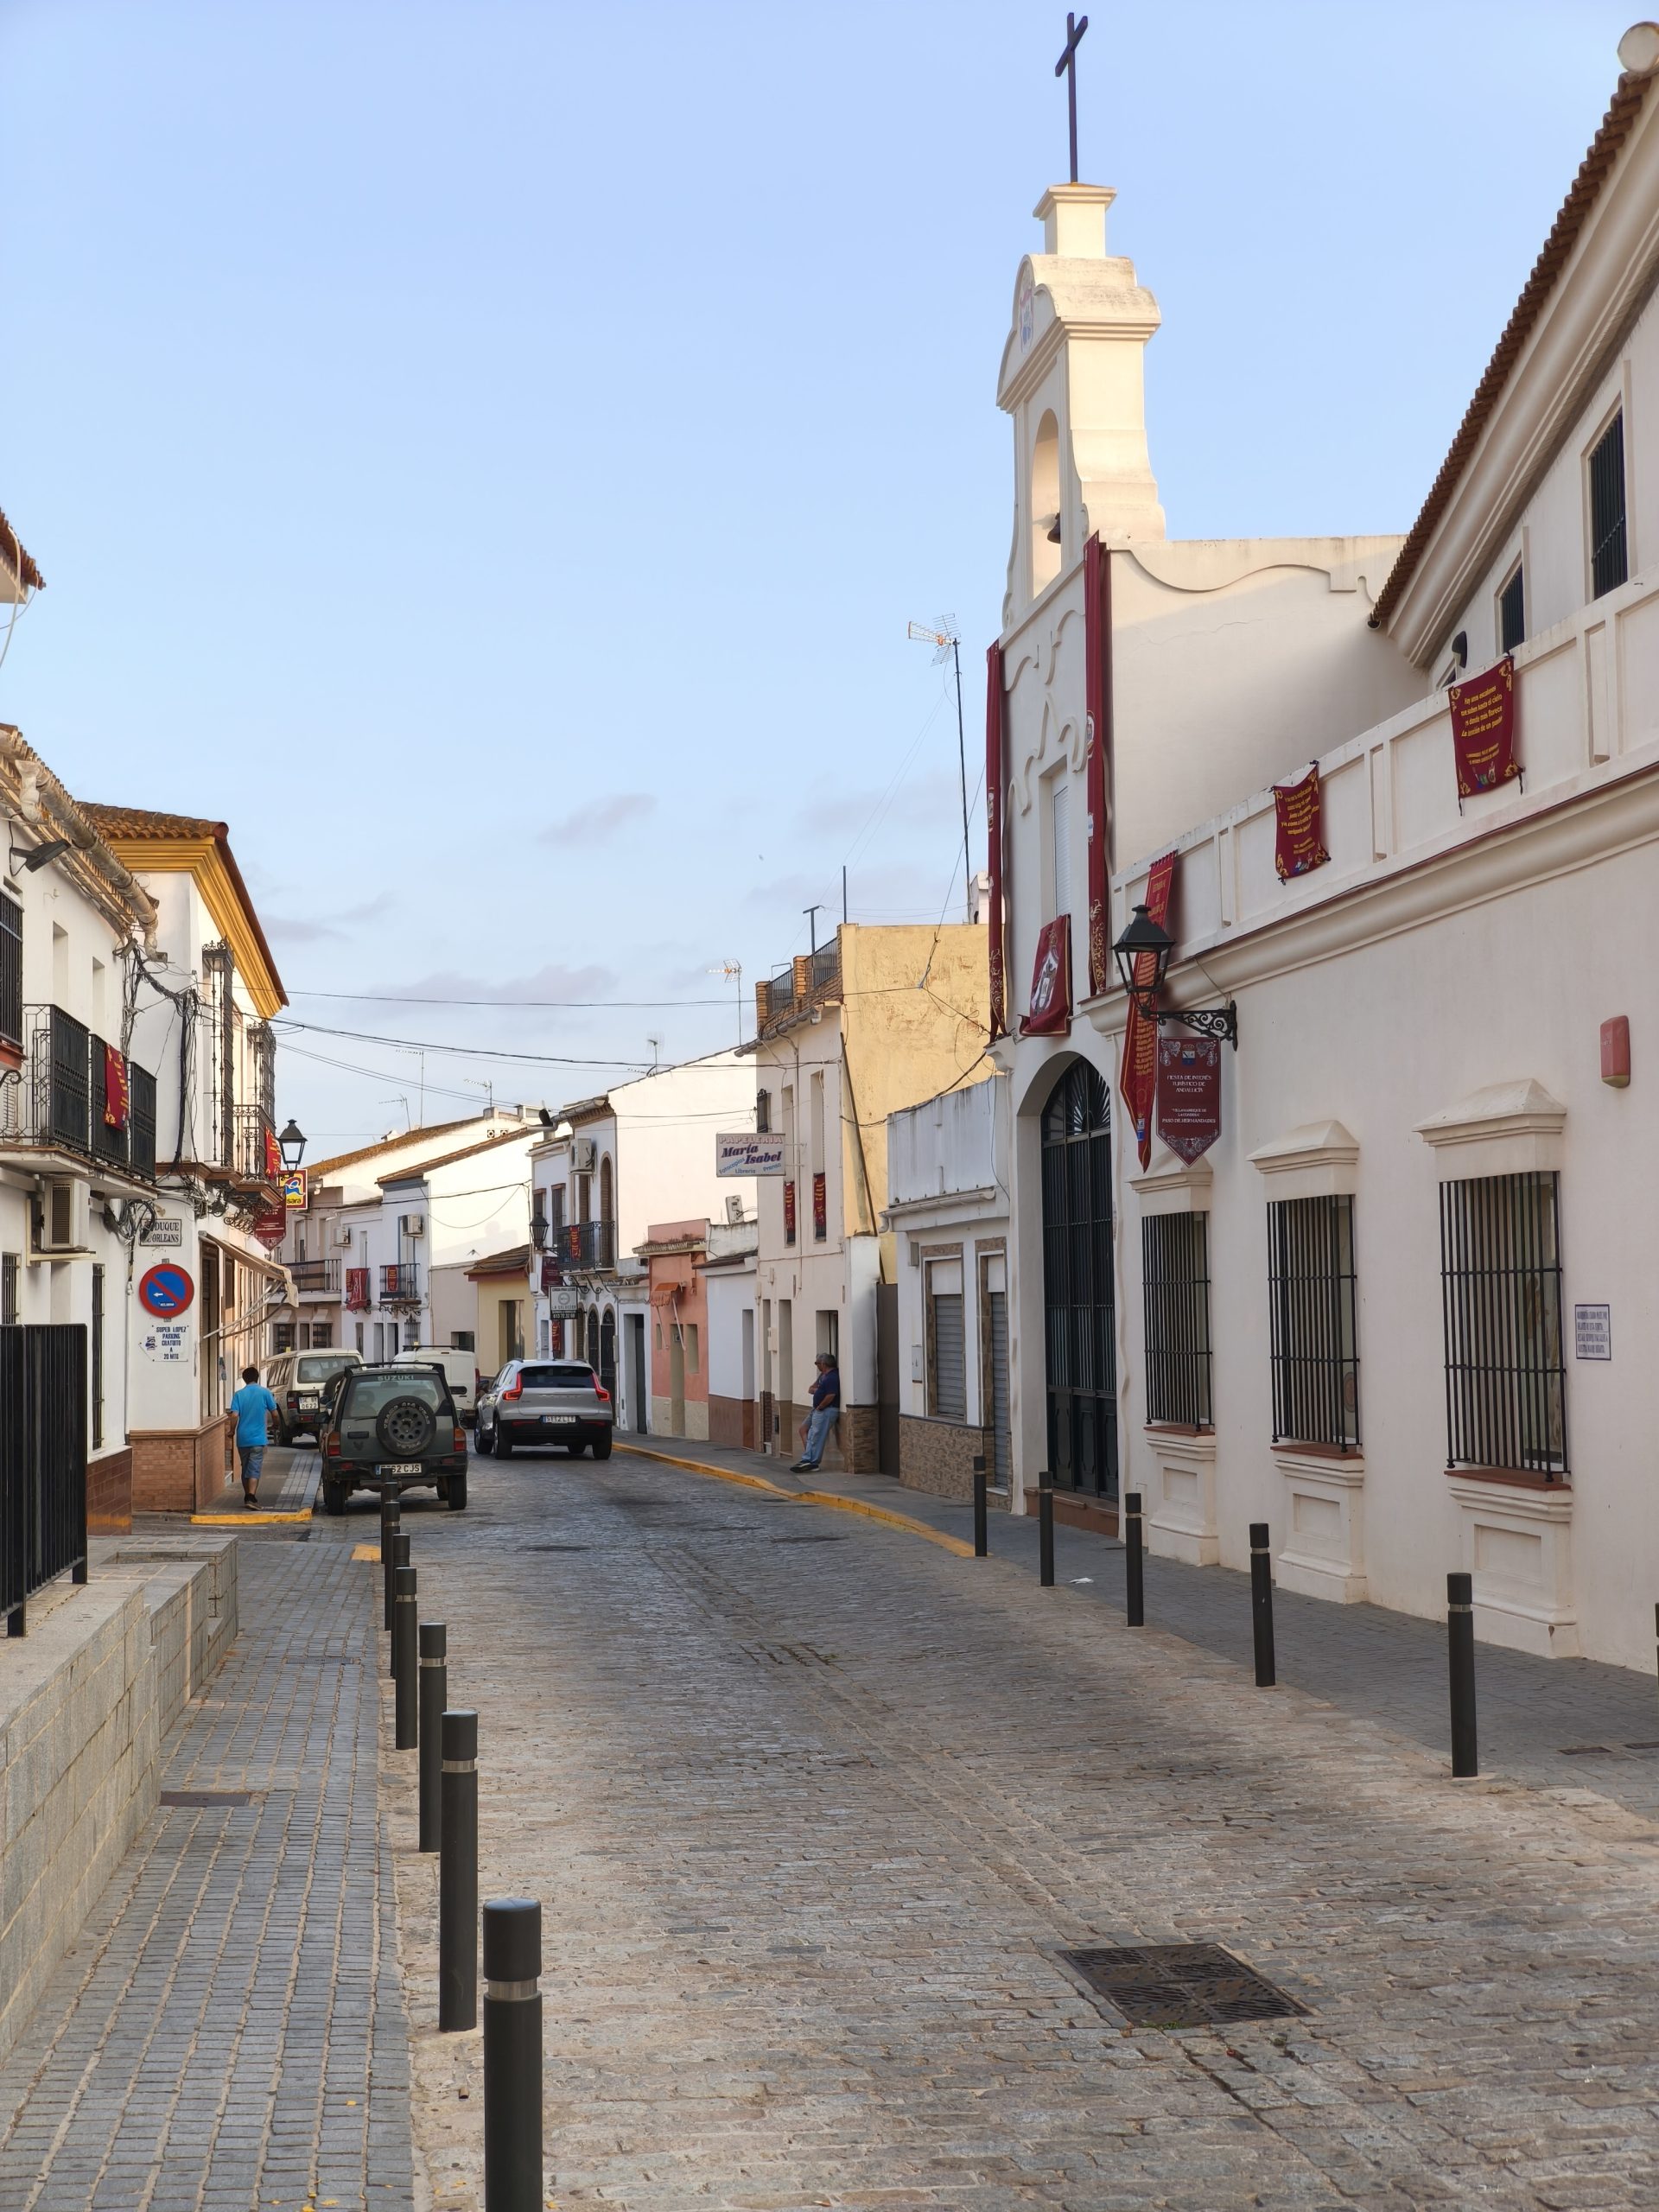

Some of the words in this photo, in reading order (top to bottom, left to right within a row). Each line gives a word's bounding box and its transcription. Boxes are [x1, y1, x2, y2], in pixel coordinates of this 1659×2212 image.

[721, 1143, 759, 1158] María
[744, 1151, 782, 1165] Isabel
[155, 1222, 180, 1231] DUQUE
[152, 1233, 180, 1243] ORLEANS
[404, 1463, 420, 1472] CJS
